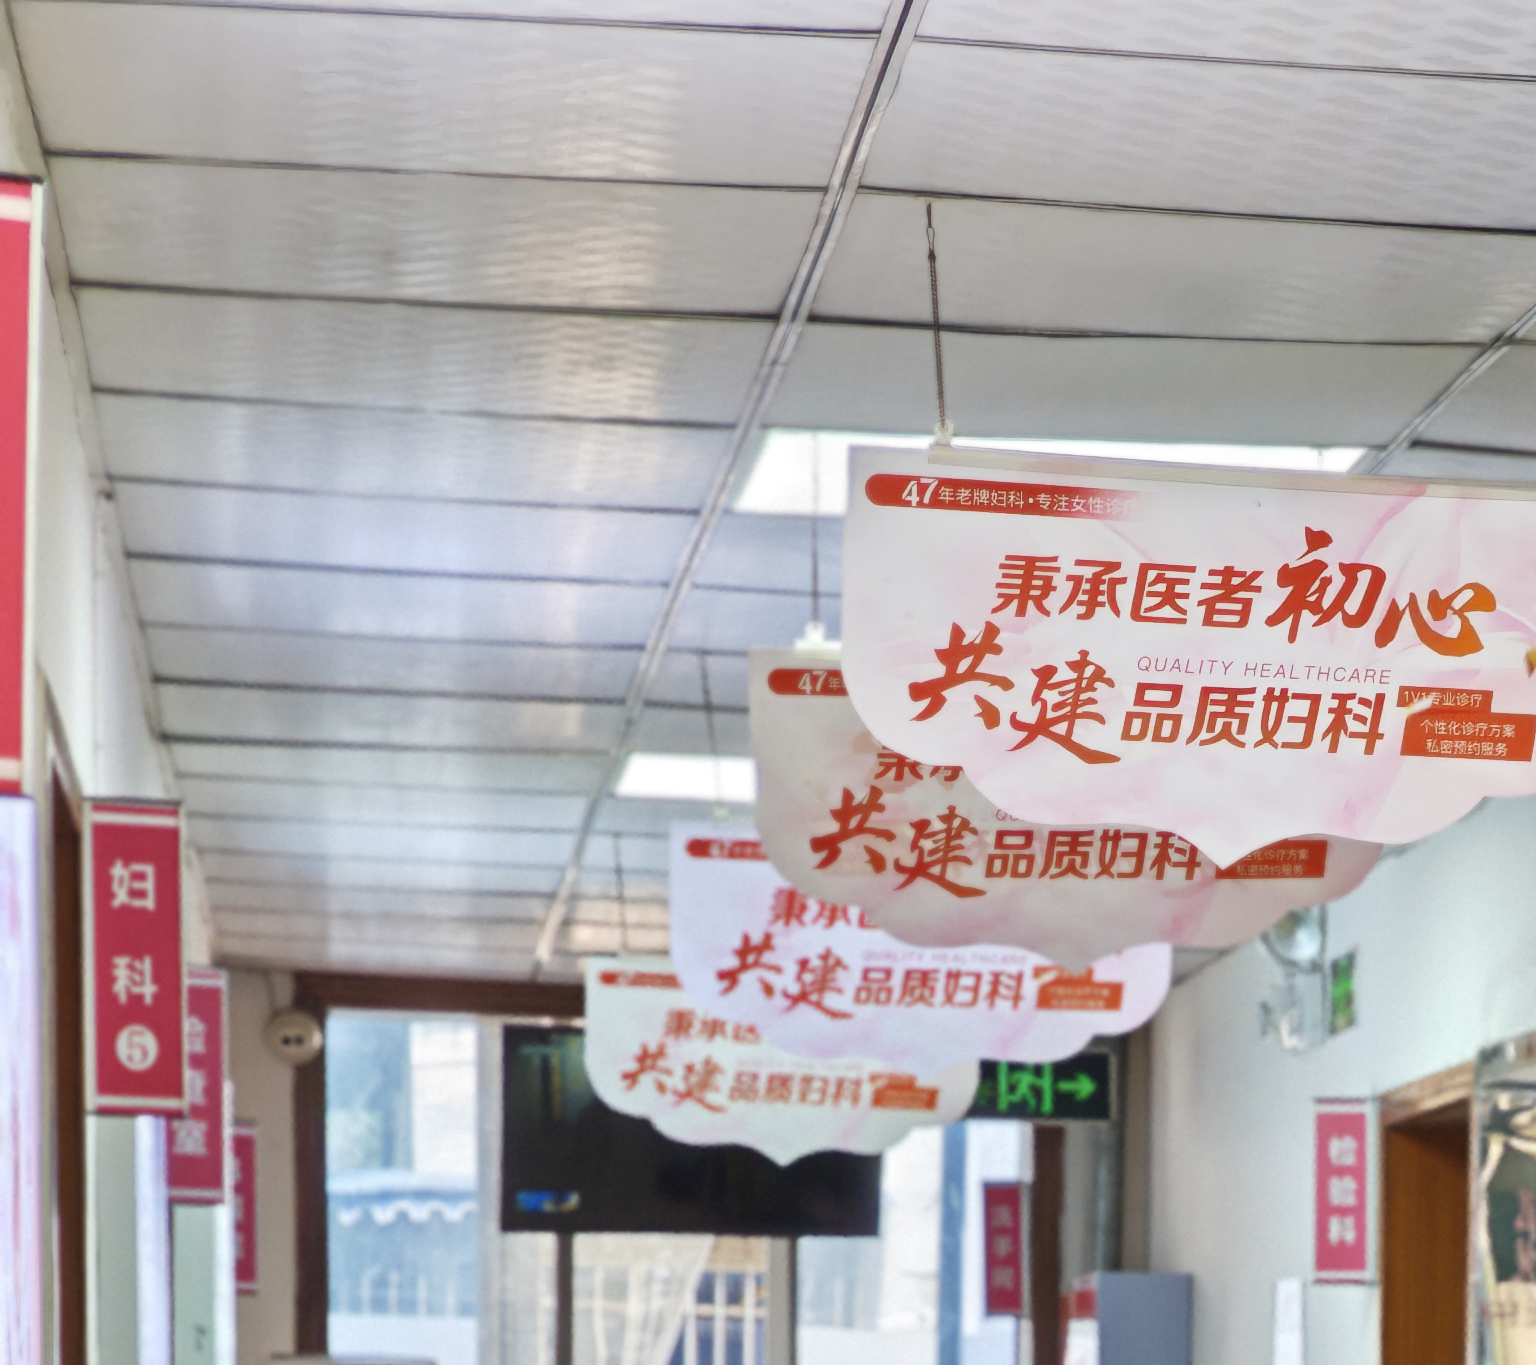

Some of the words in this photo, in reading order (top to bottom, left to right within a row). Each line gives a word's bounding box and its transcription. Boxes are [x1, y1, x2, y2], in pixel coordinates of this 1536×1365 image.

[991, 526, 1497, 657] 秉承医者初心
[798, 669, 848, 695] 47年
[909, 621, 1386, 764] 共建品质妇科
[1137, 656, 1233, 677] QUALITY
[1244, 662, 1392, 685] HEALTHCARE
[1420, 719, 1516, 738] 个性化诊疗方案
[810, 785, 1202, 898] 共建品质妇科
[716, 930, 1026, 1020] 共建品质妇科
